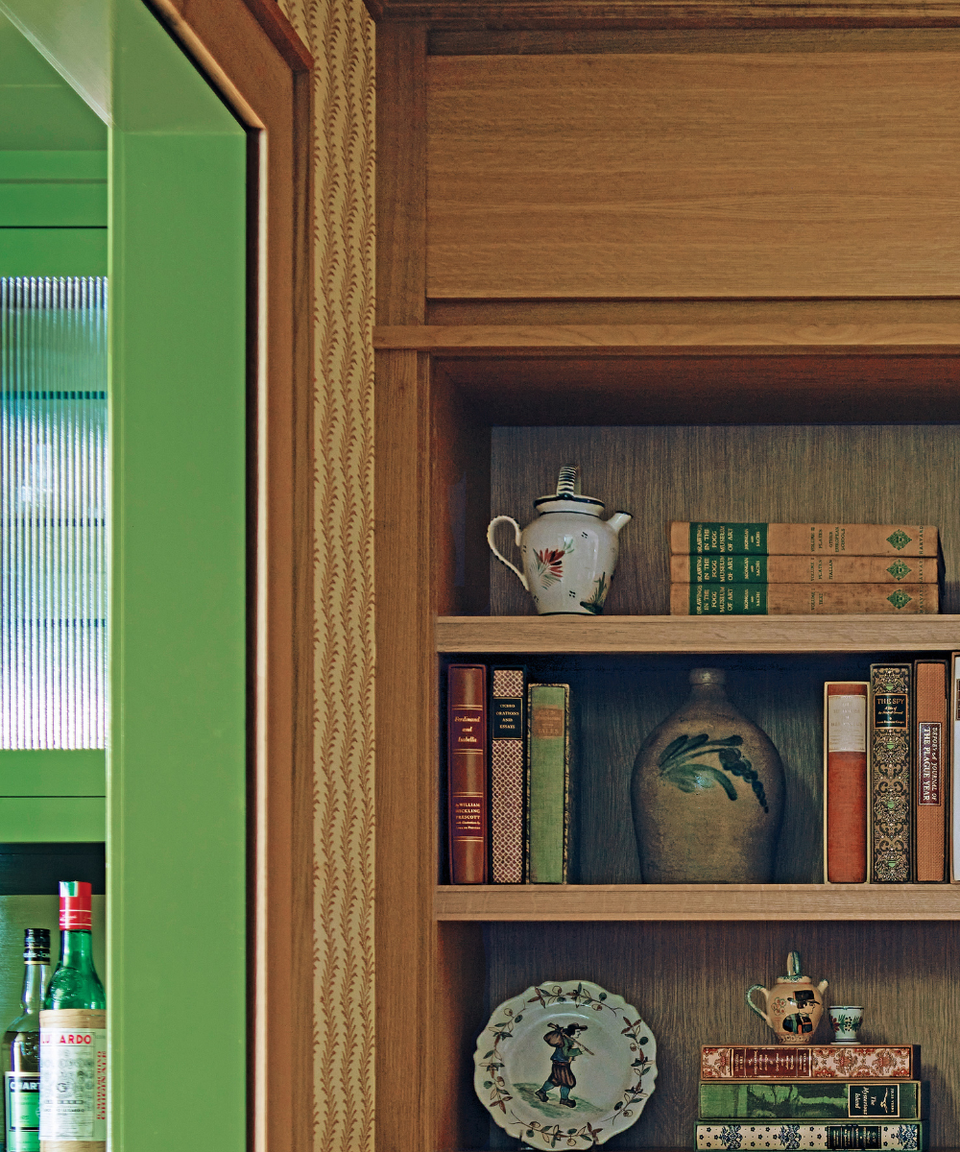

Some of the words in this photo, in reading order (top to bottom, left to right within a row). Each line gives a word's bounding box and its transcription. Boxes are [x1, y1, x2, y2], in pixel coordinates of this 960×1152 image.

[727, 543, 733, 552] OF
[704, 572, 709, 580] IN
[727, 572, 733, 581] OF
[704, 603, 709, 611] IN
[727, 603, 733, 611] OF
[932, 793, 937, 801] OF
[41, 1034, 92, 1044] LUARDO
